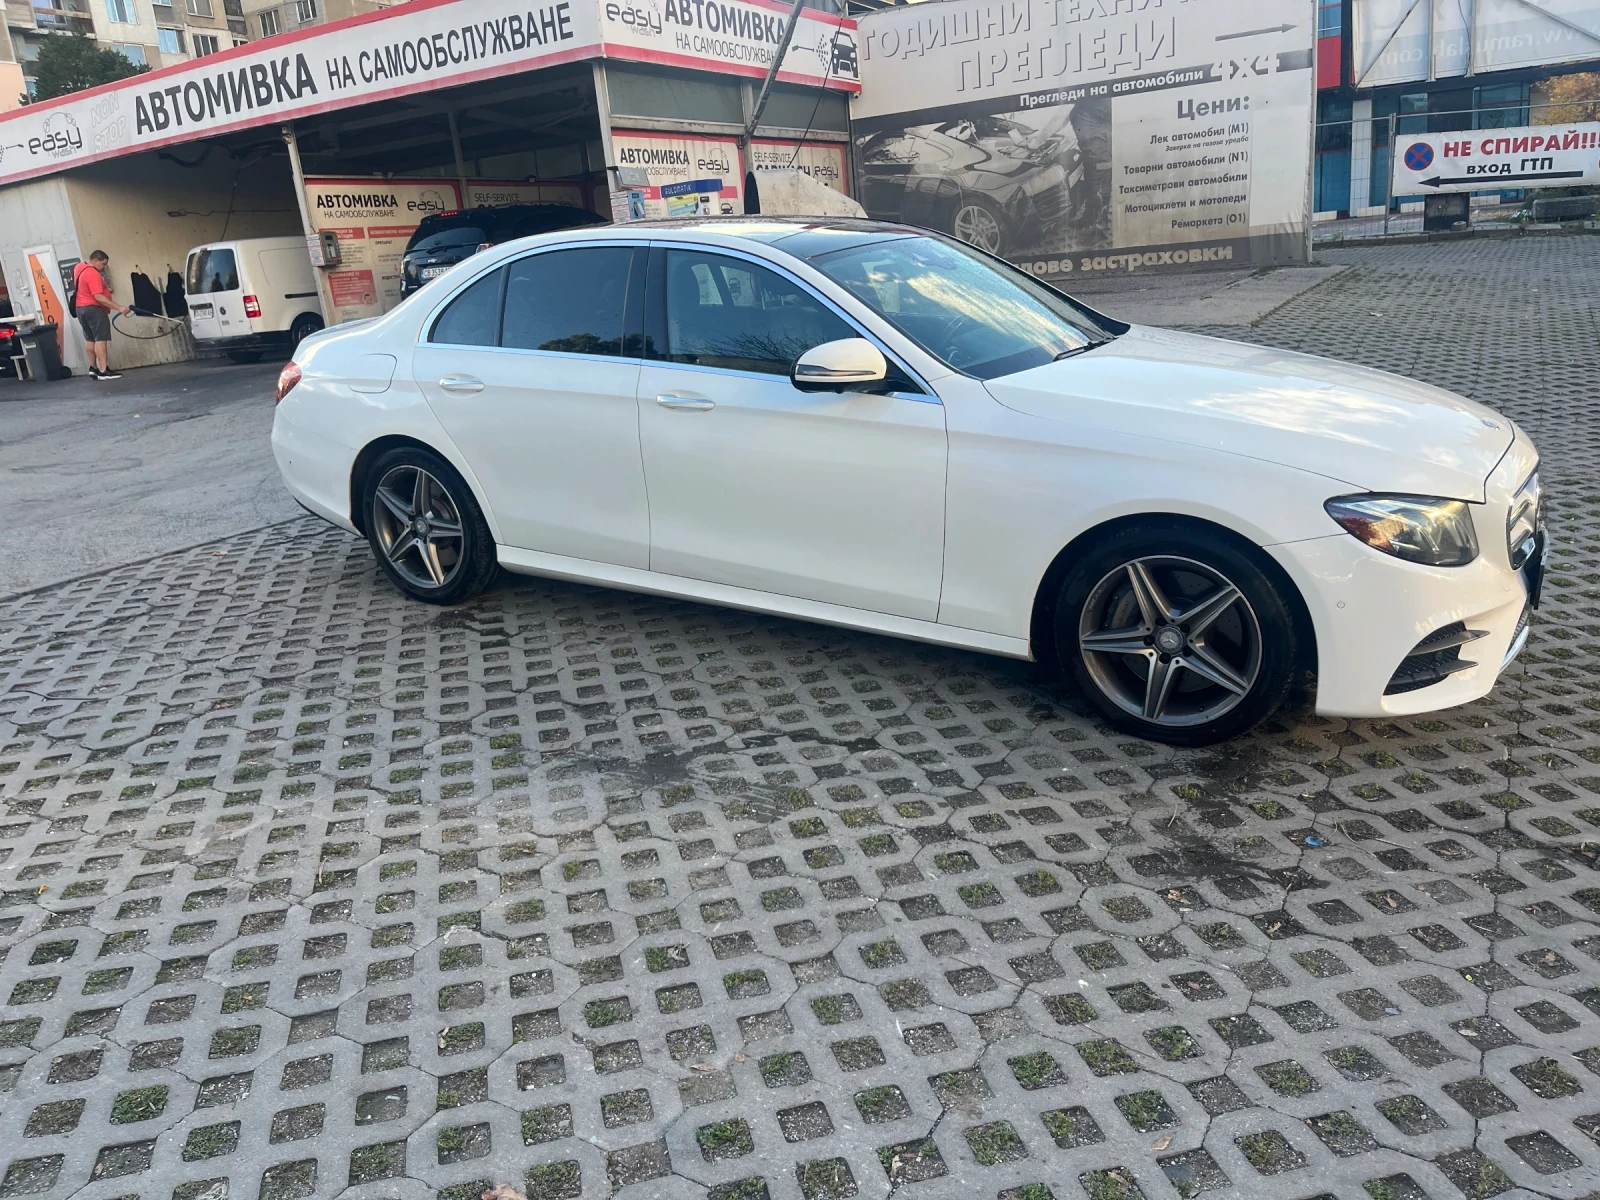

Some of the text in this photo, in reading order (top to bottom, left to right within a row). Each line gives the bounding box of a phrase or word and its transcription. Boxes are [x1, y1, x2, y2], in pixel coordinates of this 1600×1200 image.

[606, 3, 662, 34] easy
[862, 0, 1031, 60] ГОДИШНИ
[676, 32, 691, 50] НА
[956, 16, 1175, 92] ПРЕГЛЕДИ
[135, 2, 574, 135] АВТОМИВКА НА САМООБСЛУЖВАНЕ
[1019, 88, 1086, 108] Прегледи
[1090, 86, 1108, 97] на
[1112, 70, 1204, 92] автомобили
[91, 90, 120, 128] NON
[1177, 95, 1250, 120] Цени:
[28, 127, 83, 155] easy
[94, 115, 127, 153] STOP
[1149, 134, 1169, 145] Лек
[1171, 127, 1225, 142] автомобил
[620, 147, 690, 165] АВТОМИВКА
[753, 151, 791, 162] SELF-SERVICE
[1443, 141, 1472, 158] НЕ
[697, 158, 730, 173] easy
[814, 165, 839, 178] easy
[1123, 165, 1164, 175] Товарни
[1166, 156, 1226, 170] автомобили
[1520, 157, 1554, 171] ГТП
[1119, 172, 1248, 194] Таксиметрови автомобили
[316, 194, 398, 209] АВТОМИВКА
[474, 192, 520, 202] SELF-SERVICE
[1124, 200, 1187, 213] Мотоциклети
[1198, 194, 1247, 206] мотопеди
[324, 209, 396, 218] НА САМООБСЛУЖВАНЕ
[406, 200, 445, 213] easy
[1171, 216, 1223, 229] Ремаркета
[1081, 246, 1233, 271] застраховки
